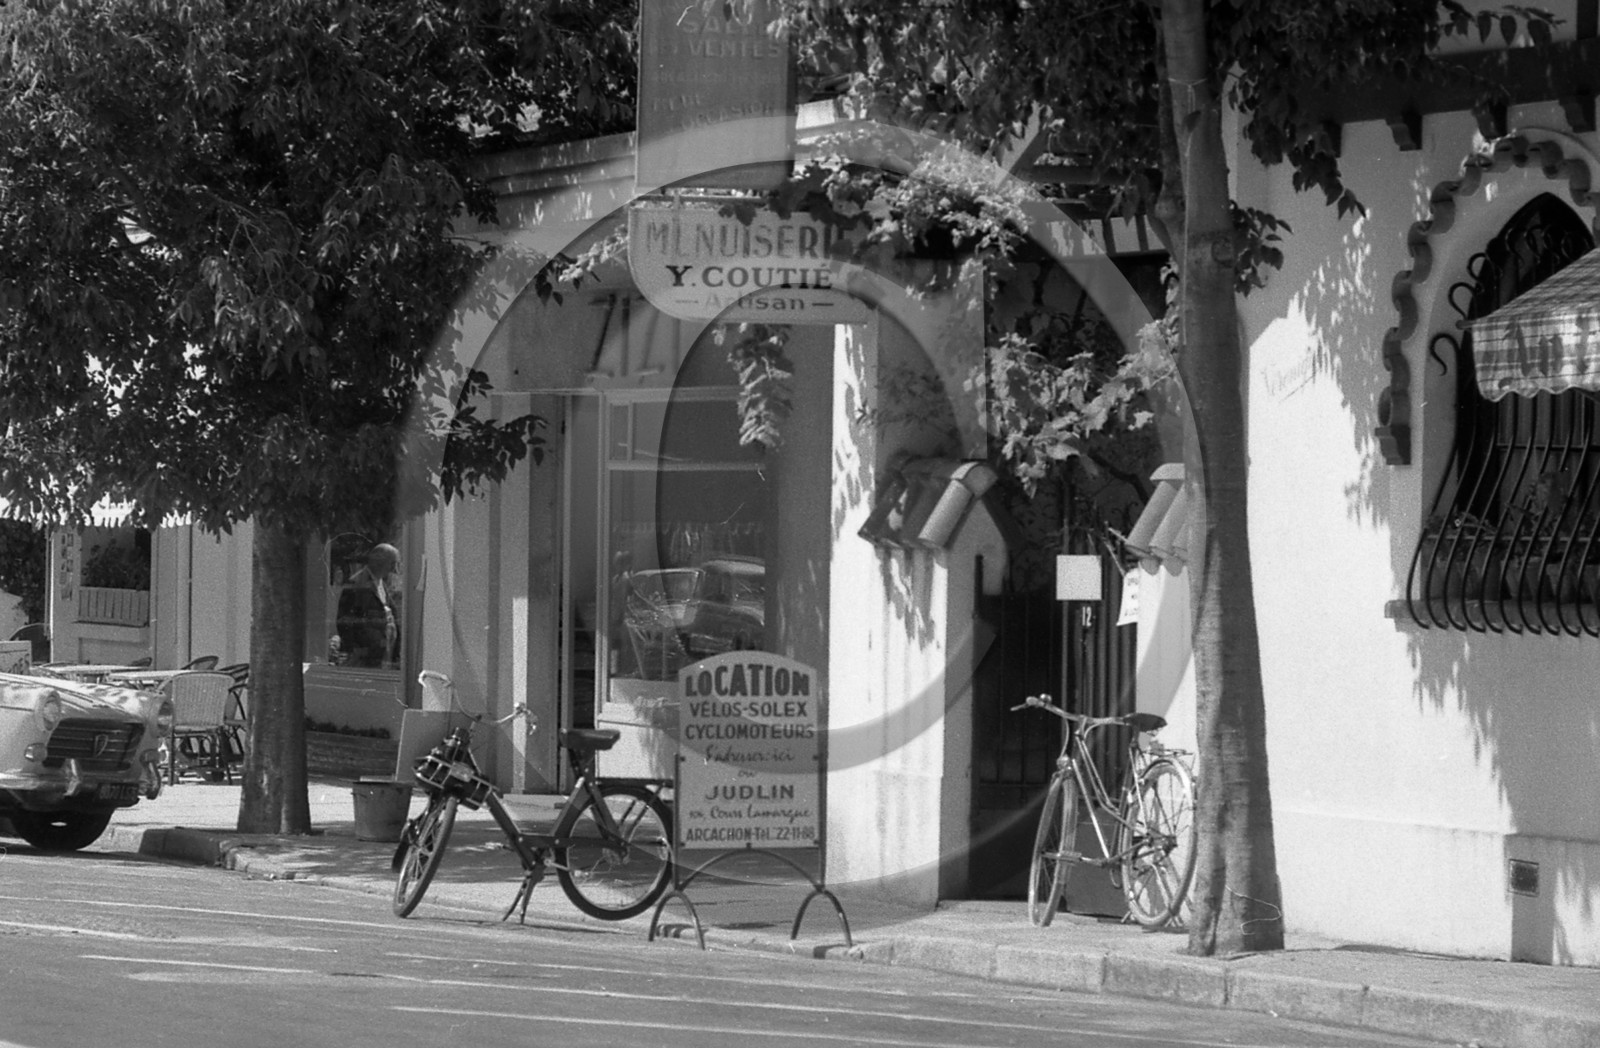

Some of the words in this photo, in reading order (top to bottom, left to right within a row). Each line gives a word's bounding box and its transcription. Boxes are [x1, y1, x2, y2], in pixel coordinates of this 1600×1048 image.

[699, 294, 805, 311] Artisan
[685, 663, 810, 697] LOCATION
[689, 701, 808, 718] VÉLOS-SOLEX
[685, 723, 815, 740] CYCLOMOTEURS
[705, 784, 795, 800] JUDLIN
